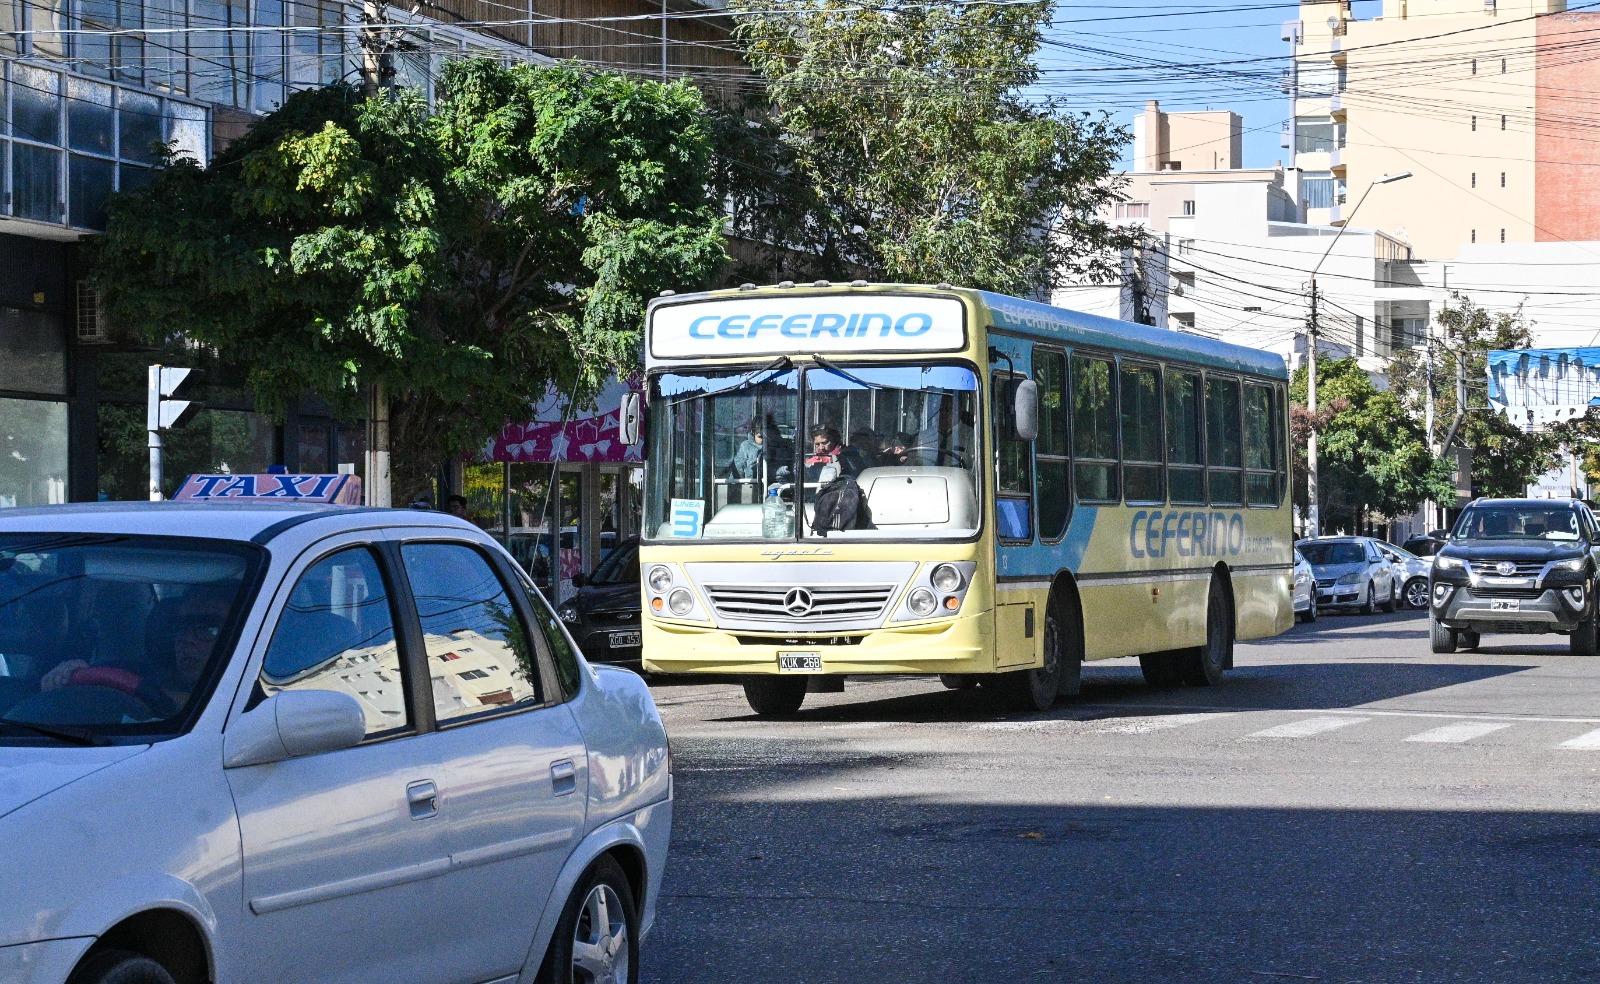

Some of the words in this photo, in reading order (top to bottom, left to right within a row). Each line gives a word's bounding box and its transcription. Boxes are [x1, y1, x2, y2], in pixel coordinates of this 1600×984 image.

[688, 312, 933, 340] CEFERINO
[191, 474, 339, 499] TAXI
[675, 500, 701, 508] LINEA
[673, 510, 699, 537] 3
[1130, 510, 1244, 559] CEFERINO
[781, 657, 799, 669] KUK
[803, 656, 820, 668] 268
